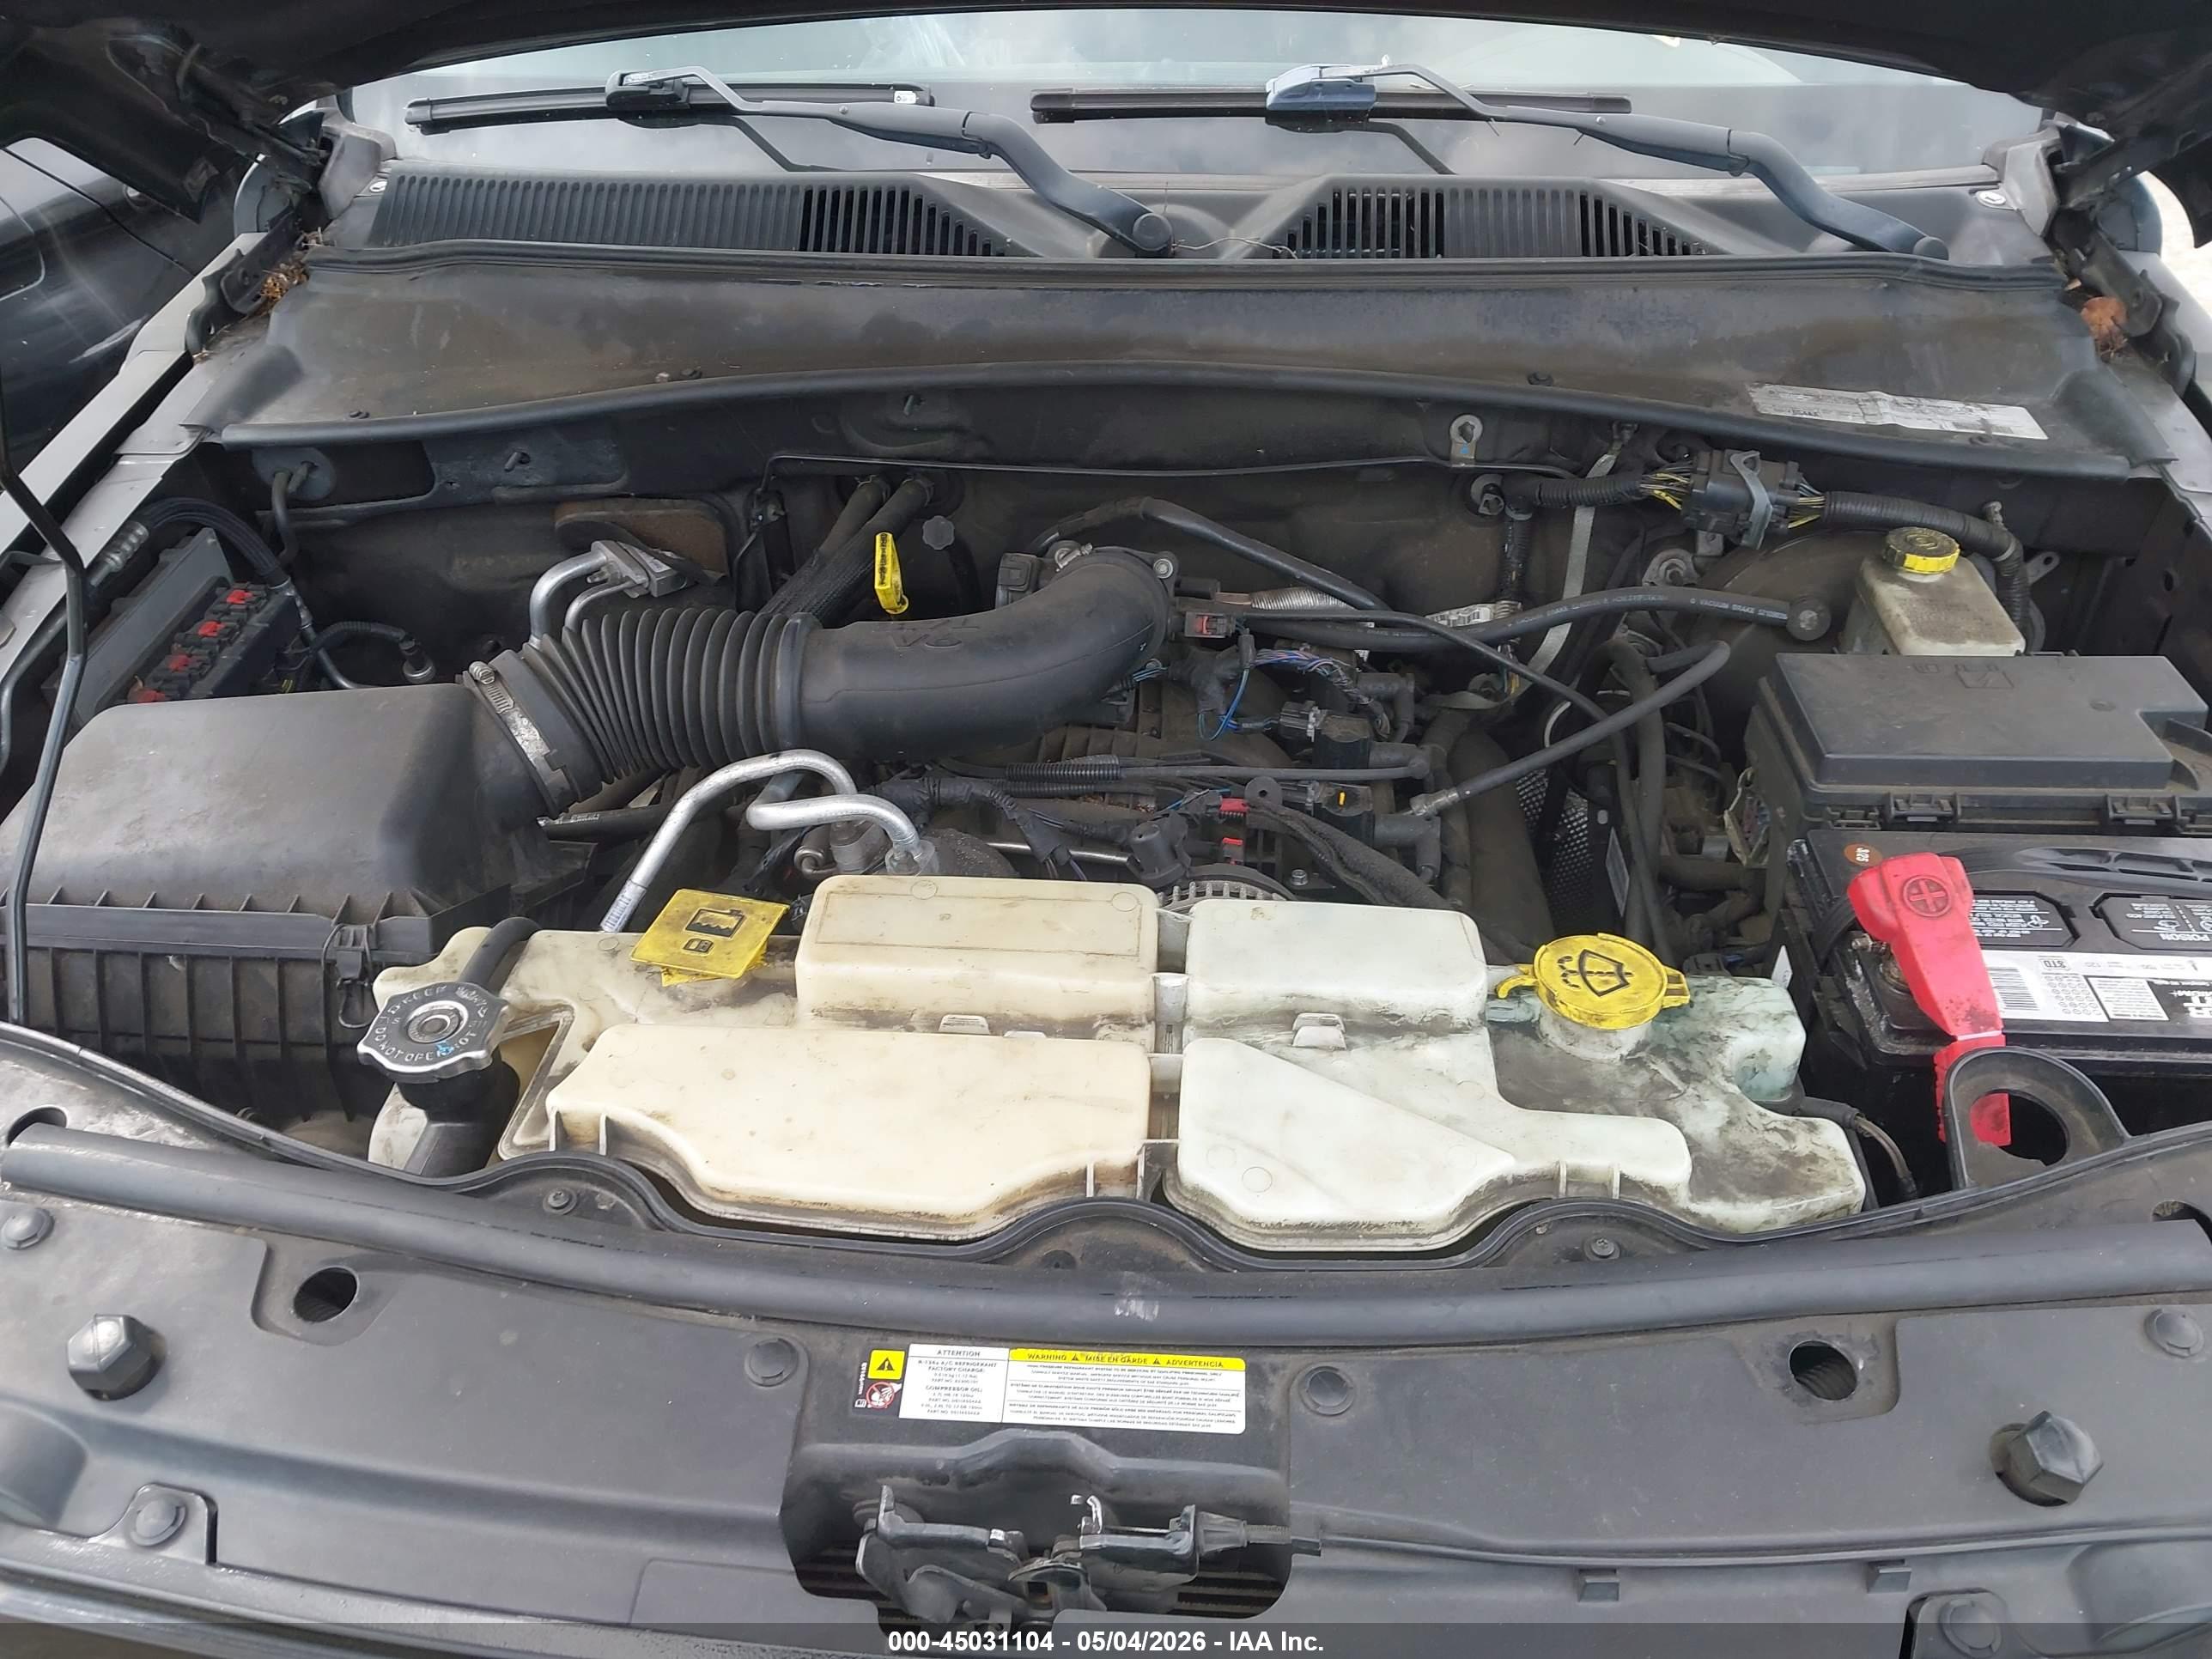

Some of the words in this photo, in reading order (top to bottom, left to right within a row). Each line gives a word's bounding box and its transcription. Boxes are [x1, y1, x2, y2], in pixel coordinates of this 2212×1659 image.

[2160, 933, 2211, 942] POISON
[1027, 1352, 1067, 1361] WARNING
[1165, 1358, 1224, 1368] ADVERTENCIA
